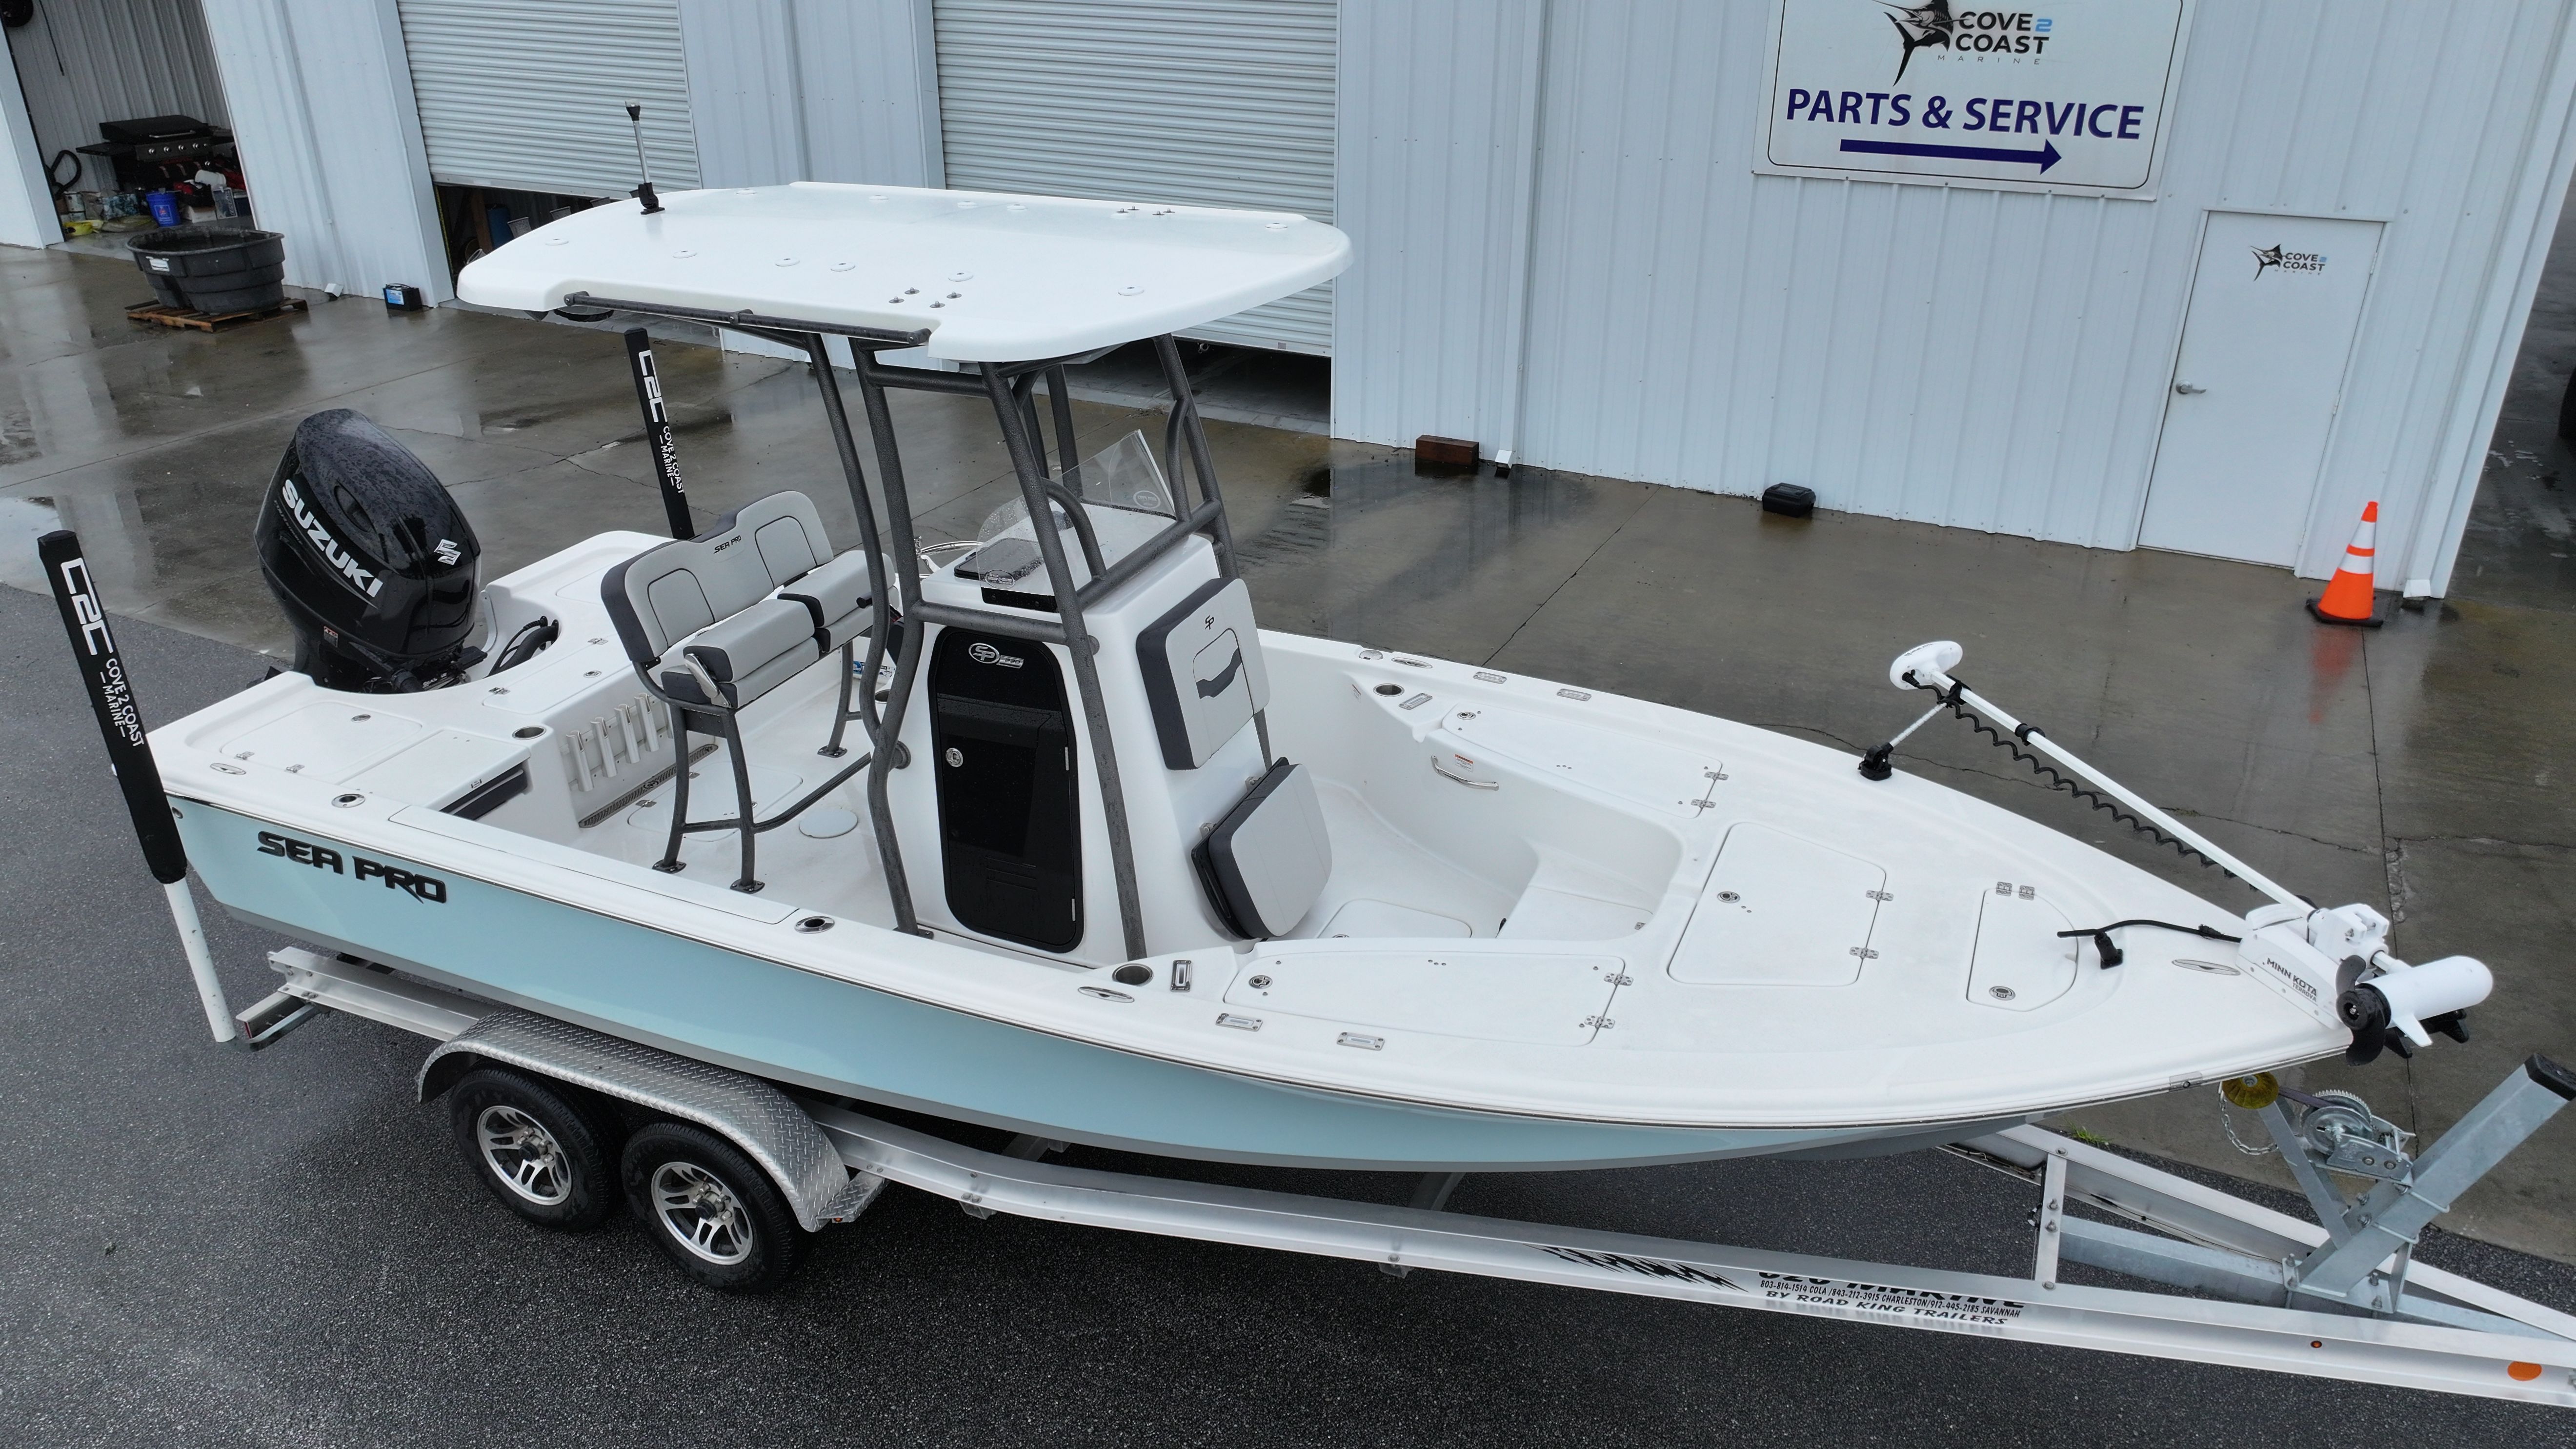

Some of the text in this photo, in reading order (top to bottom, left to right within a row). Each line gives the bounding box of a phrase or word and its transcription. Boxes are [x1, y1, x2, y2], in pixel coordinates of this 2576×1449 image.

[1958, 11, 2053, 32] COVE 2
[1937, 55, 2040, 65] MARINE
[1955, 33, 2050, 54] COAST
[1786, 88, 2144, 141] PARTS & SERVICE
[2283, 261, 2325, 271] COAST
[2285, 252, 2318, 262] COVE
[660, 445, 674, 478] MARINE
[663, 425, 675, 454] COVE
[672, 462, 684, 493] COAST
[282, 479, 383, 598] SUZUKI
[714, 535, 742, 554] SEA PRO
[102, 685, 126, 727] MARINE
[105, 658, 144, 747] COVE 2 COAST
[257, 831, 447, 904] SEA PRO
[2267, 957, 2317, 997] MINN KOTA
[2293, 982, 2316, 1002] TERROVA
[1760, 1280, 1808, 1292] 803-814-1514
[1809, 1286, 1827, 1294] COLA
[1980, 1306, 2021, 1318] SAVANNAH
[1766, 1290, 1791, 1299] BY
[1796, 1294, 1849, 1306] ROAD
[1856, 1301, 1906, 1313] KING
[1913, 1308, 2008, 1325] TRAILERS
